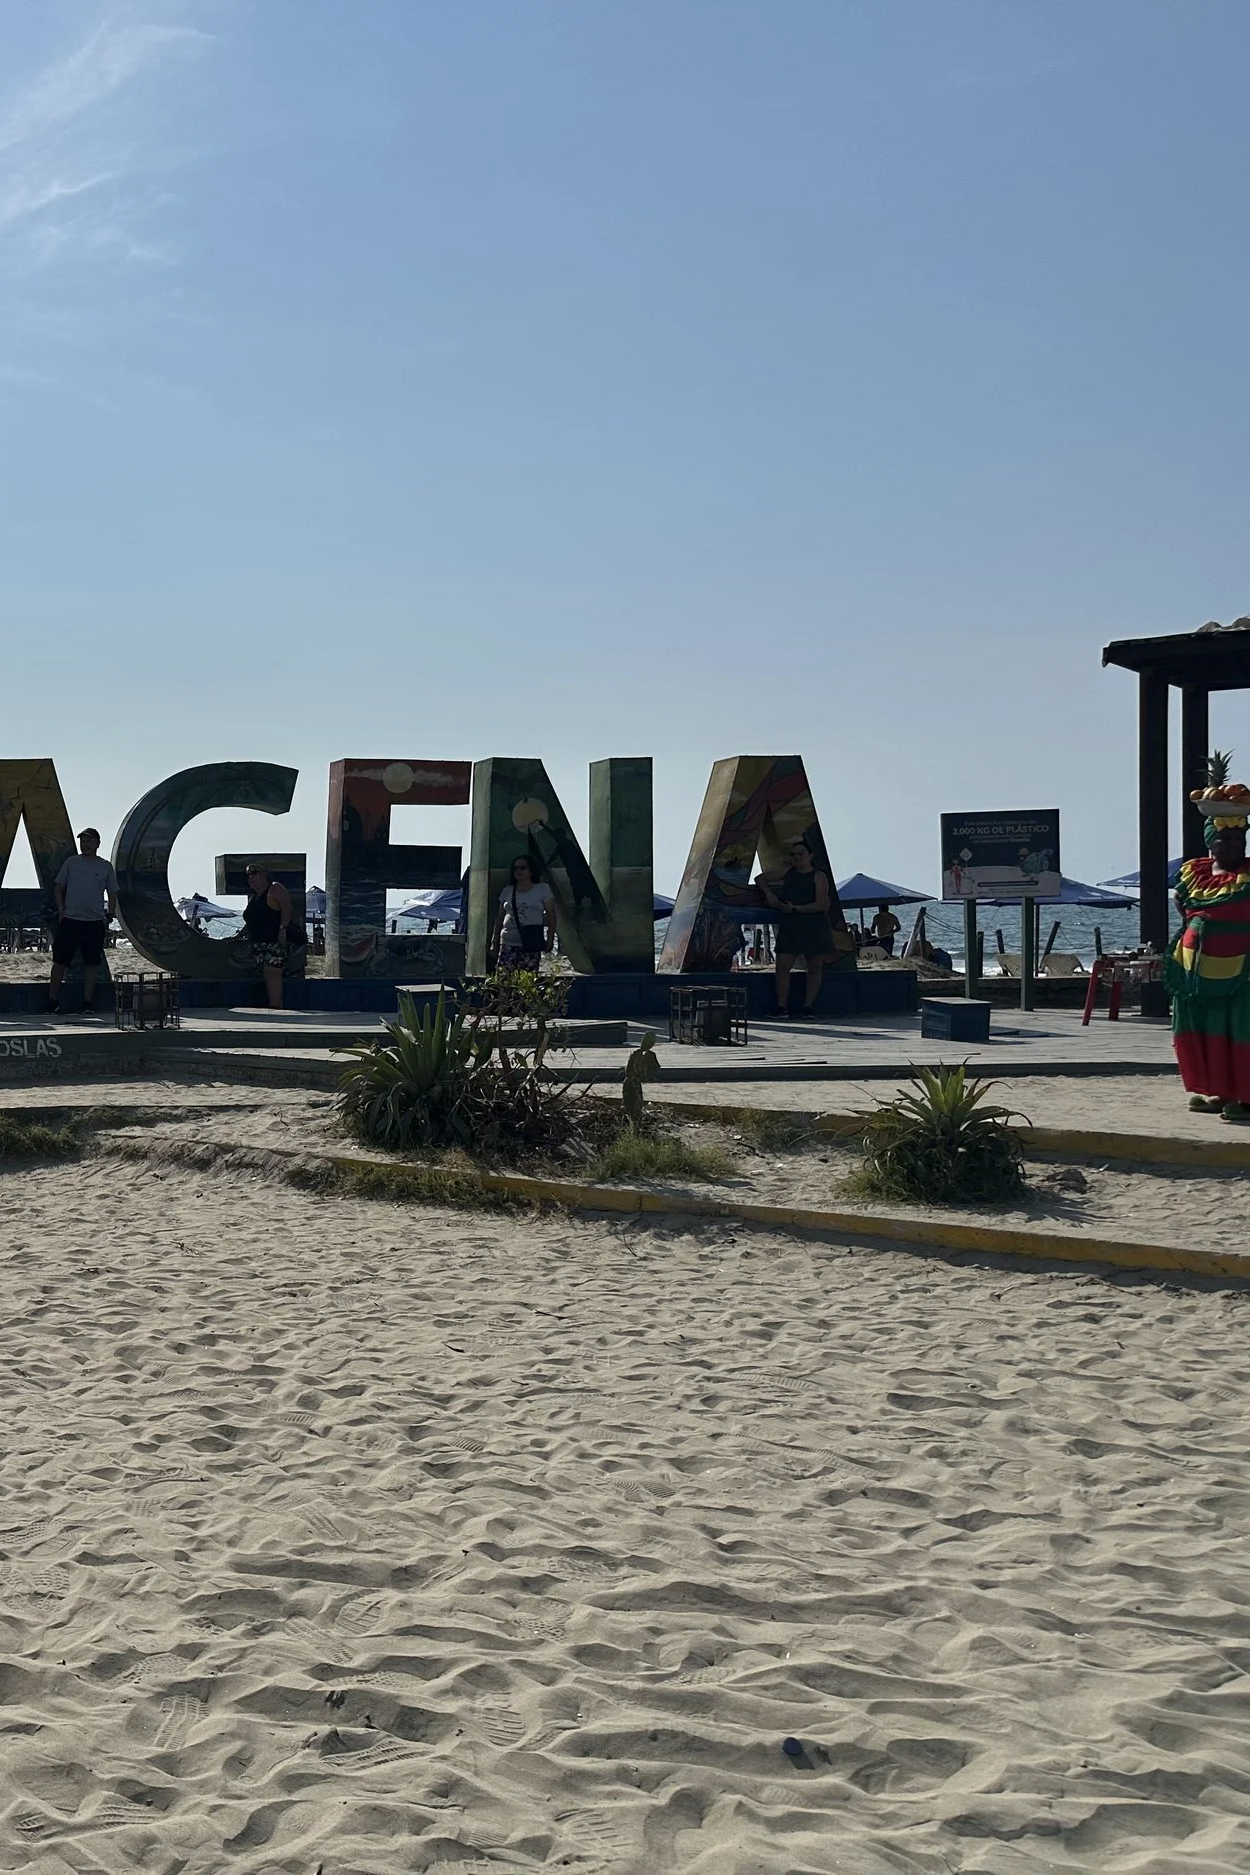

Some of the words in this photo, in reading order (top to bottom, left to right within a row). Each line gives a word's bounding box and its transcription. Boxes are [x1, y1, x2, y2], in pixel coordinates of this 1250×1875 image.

[952, 826, 975, 836] 3.000
[977, 825, 990, 835] KG
[992, 825, 1005, 834] DE
[1006, 823, 1050, 833] PLÁSTICO
